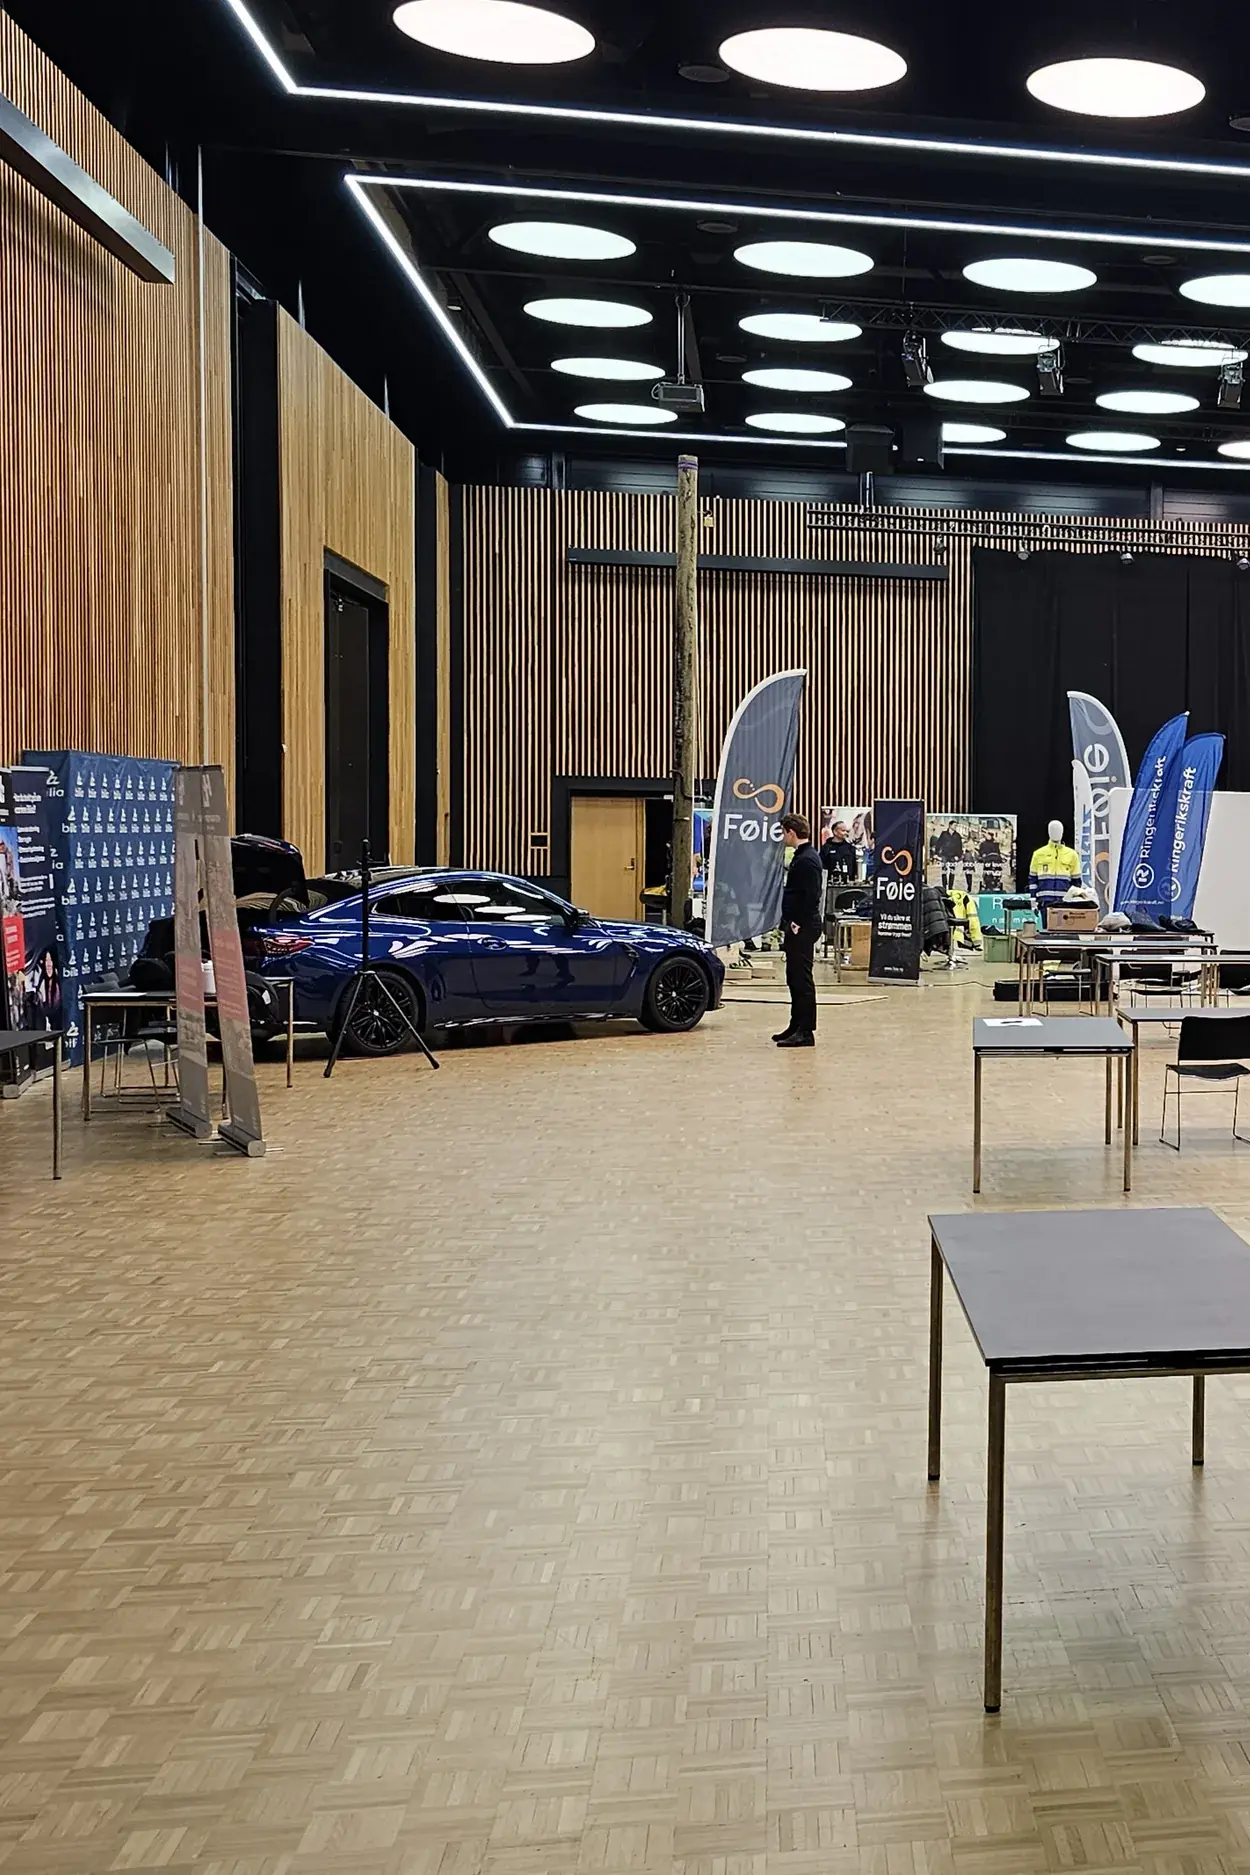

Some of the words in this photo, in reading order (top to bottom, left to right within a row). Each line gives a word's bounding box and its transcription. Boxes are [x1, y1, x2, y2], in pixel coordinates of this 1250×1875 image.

[723, 813, 784, 842] Føie
[1169, 766, 1197, 873] Ringerikskraft
[876, 876, 915, 901] Føie
[877, 921, 912, 931] strømmen
